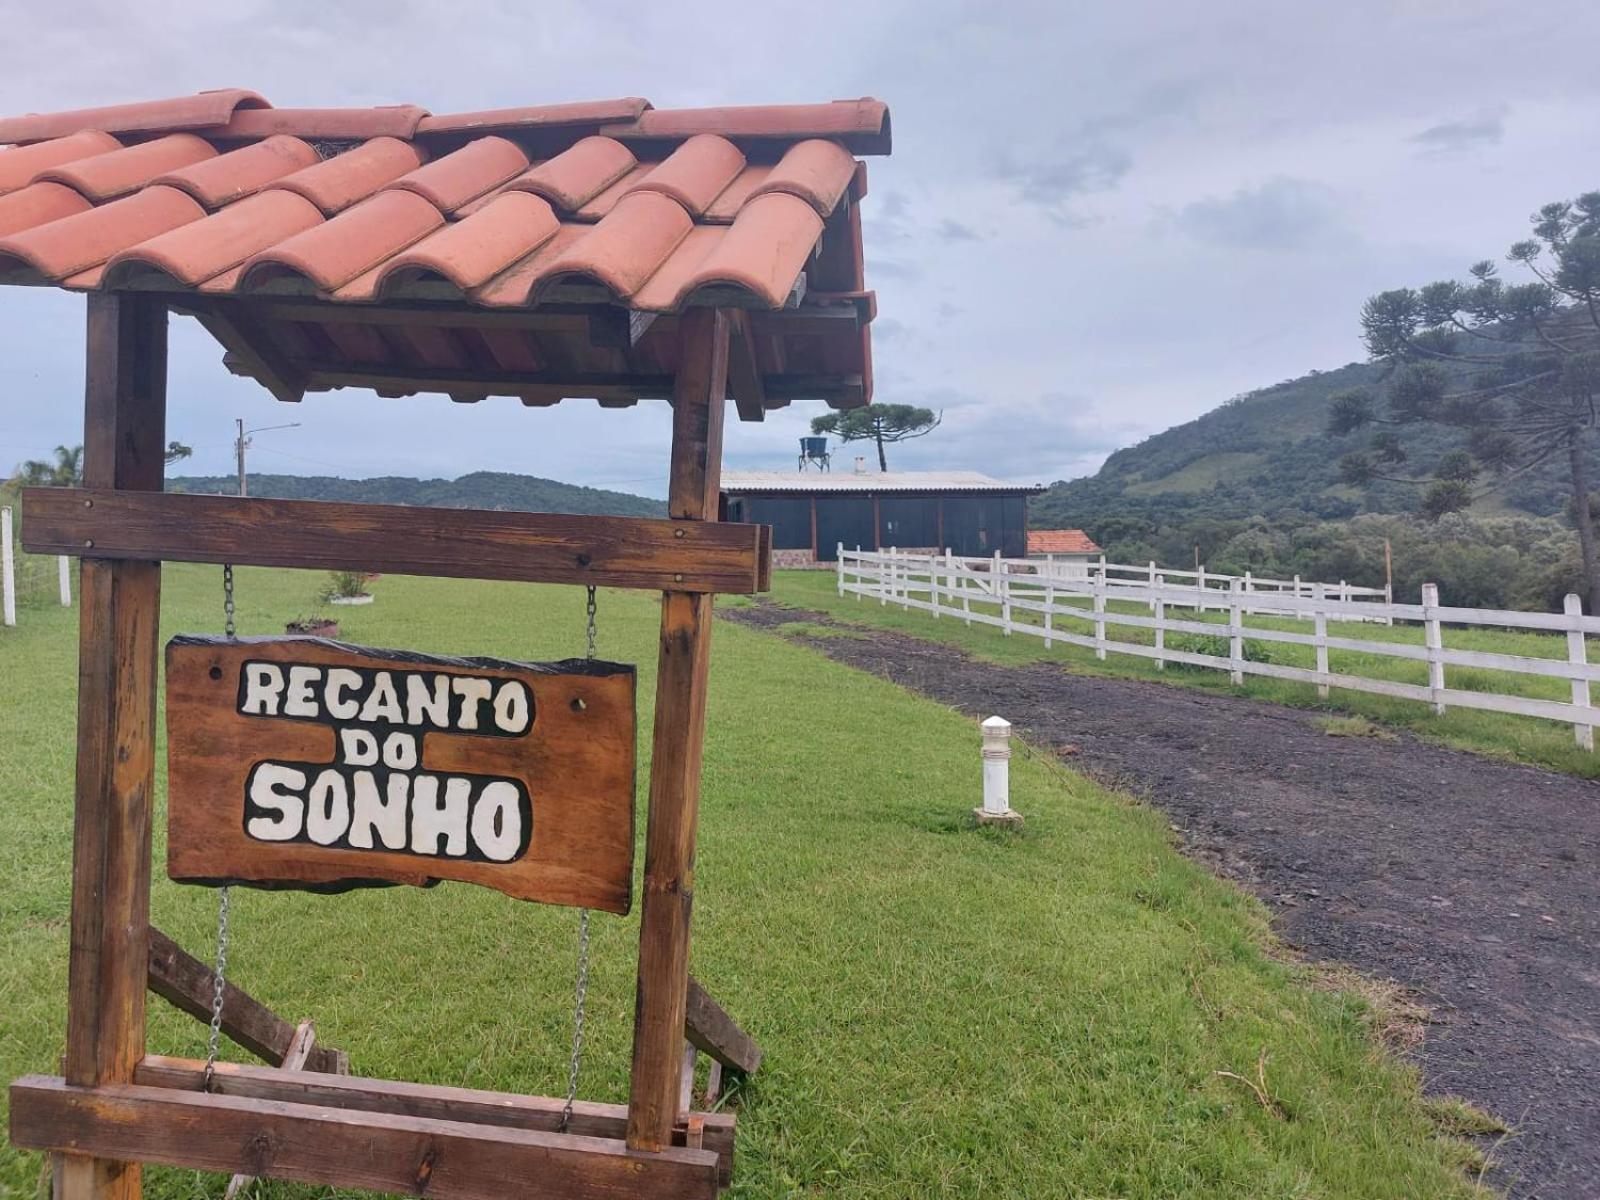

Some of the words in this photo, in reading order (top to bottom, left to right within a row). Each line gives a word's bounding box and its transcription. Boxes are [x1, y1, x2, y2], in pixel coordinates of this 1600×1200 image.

[241, 662, 530, 734] RECANTO
[340, 728, 418, 771] DO
[247, 762, 522, 862] SONHO
